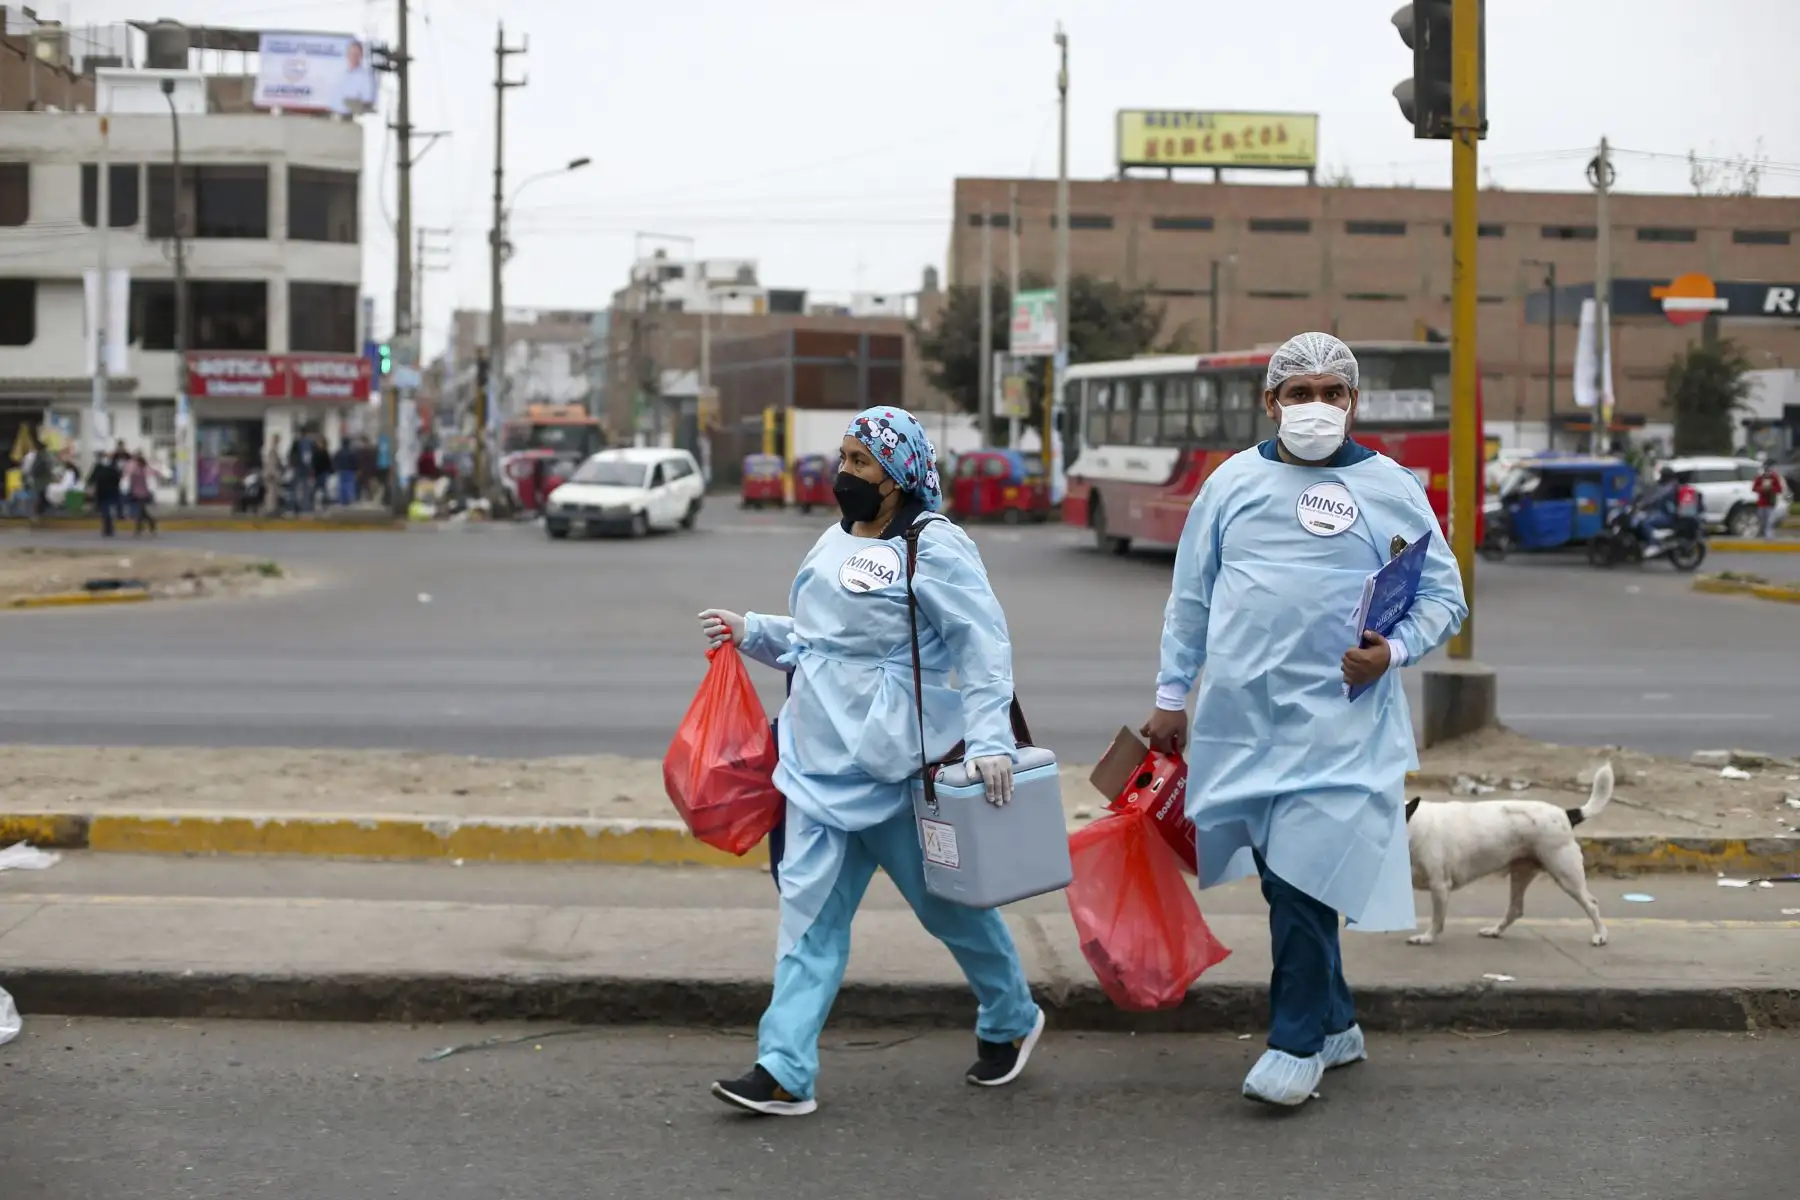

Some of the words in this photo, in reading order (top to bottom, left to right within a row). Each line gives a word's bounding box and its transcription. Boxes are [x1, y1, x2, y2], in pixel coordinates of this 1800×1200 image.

[1763, 286, 1800, 313] R
[1300, 493, 1354, 519] MINSA
[846, 555, 895, 585] MINSA
